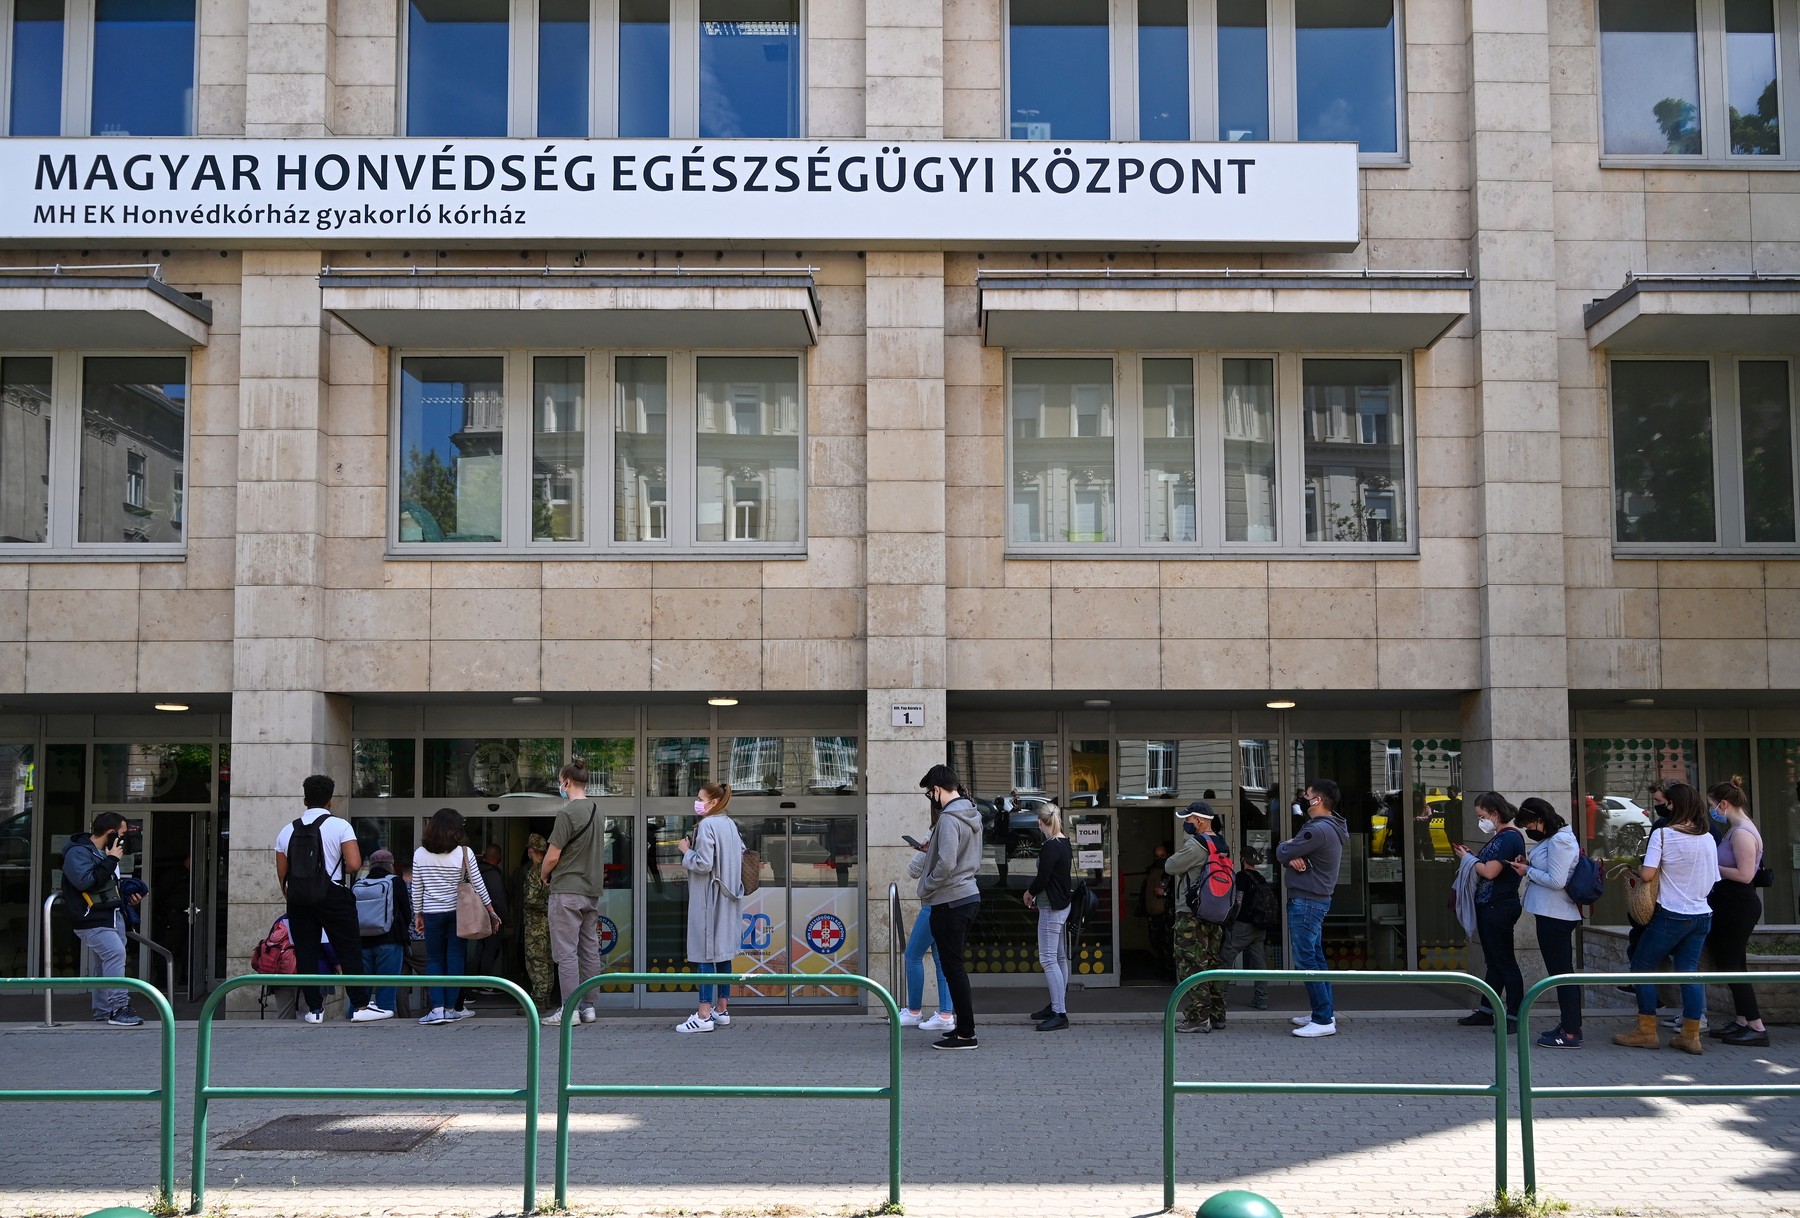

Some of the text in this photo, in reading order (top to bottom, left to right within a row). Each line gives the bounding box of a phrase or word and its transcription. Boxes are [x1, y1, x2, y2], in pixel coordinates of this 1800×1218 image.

[34, 145, 1256, 195] MAGYAR HONVÉDSÉG EGÉSZSÉGÜGYI KÖZPONT
[33, 203, 526, 231] MH EK Honvédkórház gyakorló kórház
[903, 712, 913, 724] 1.
[741, 913, 771, 949] 20
